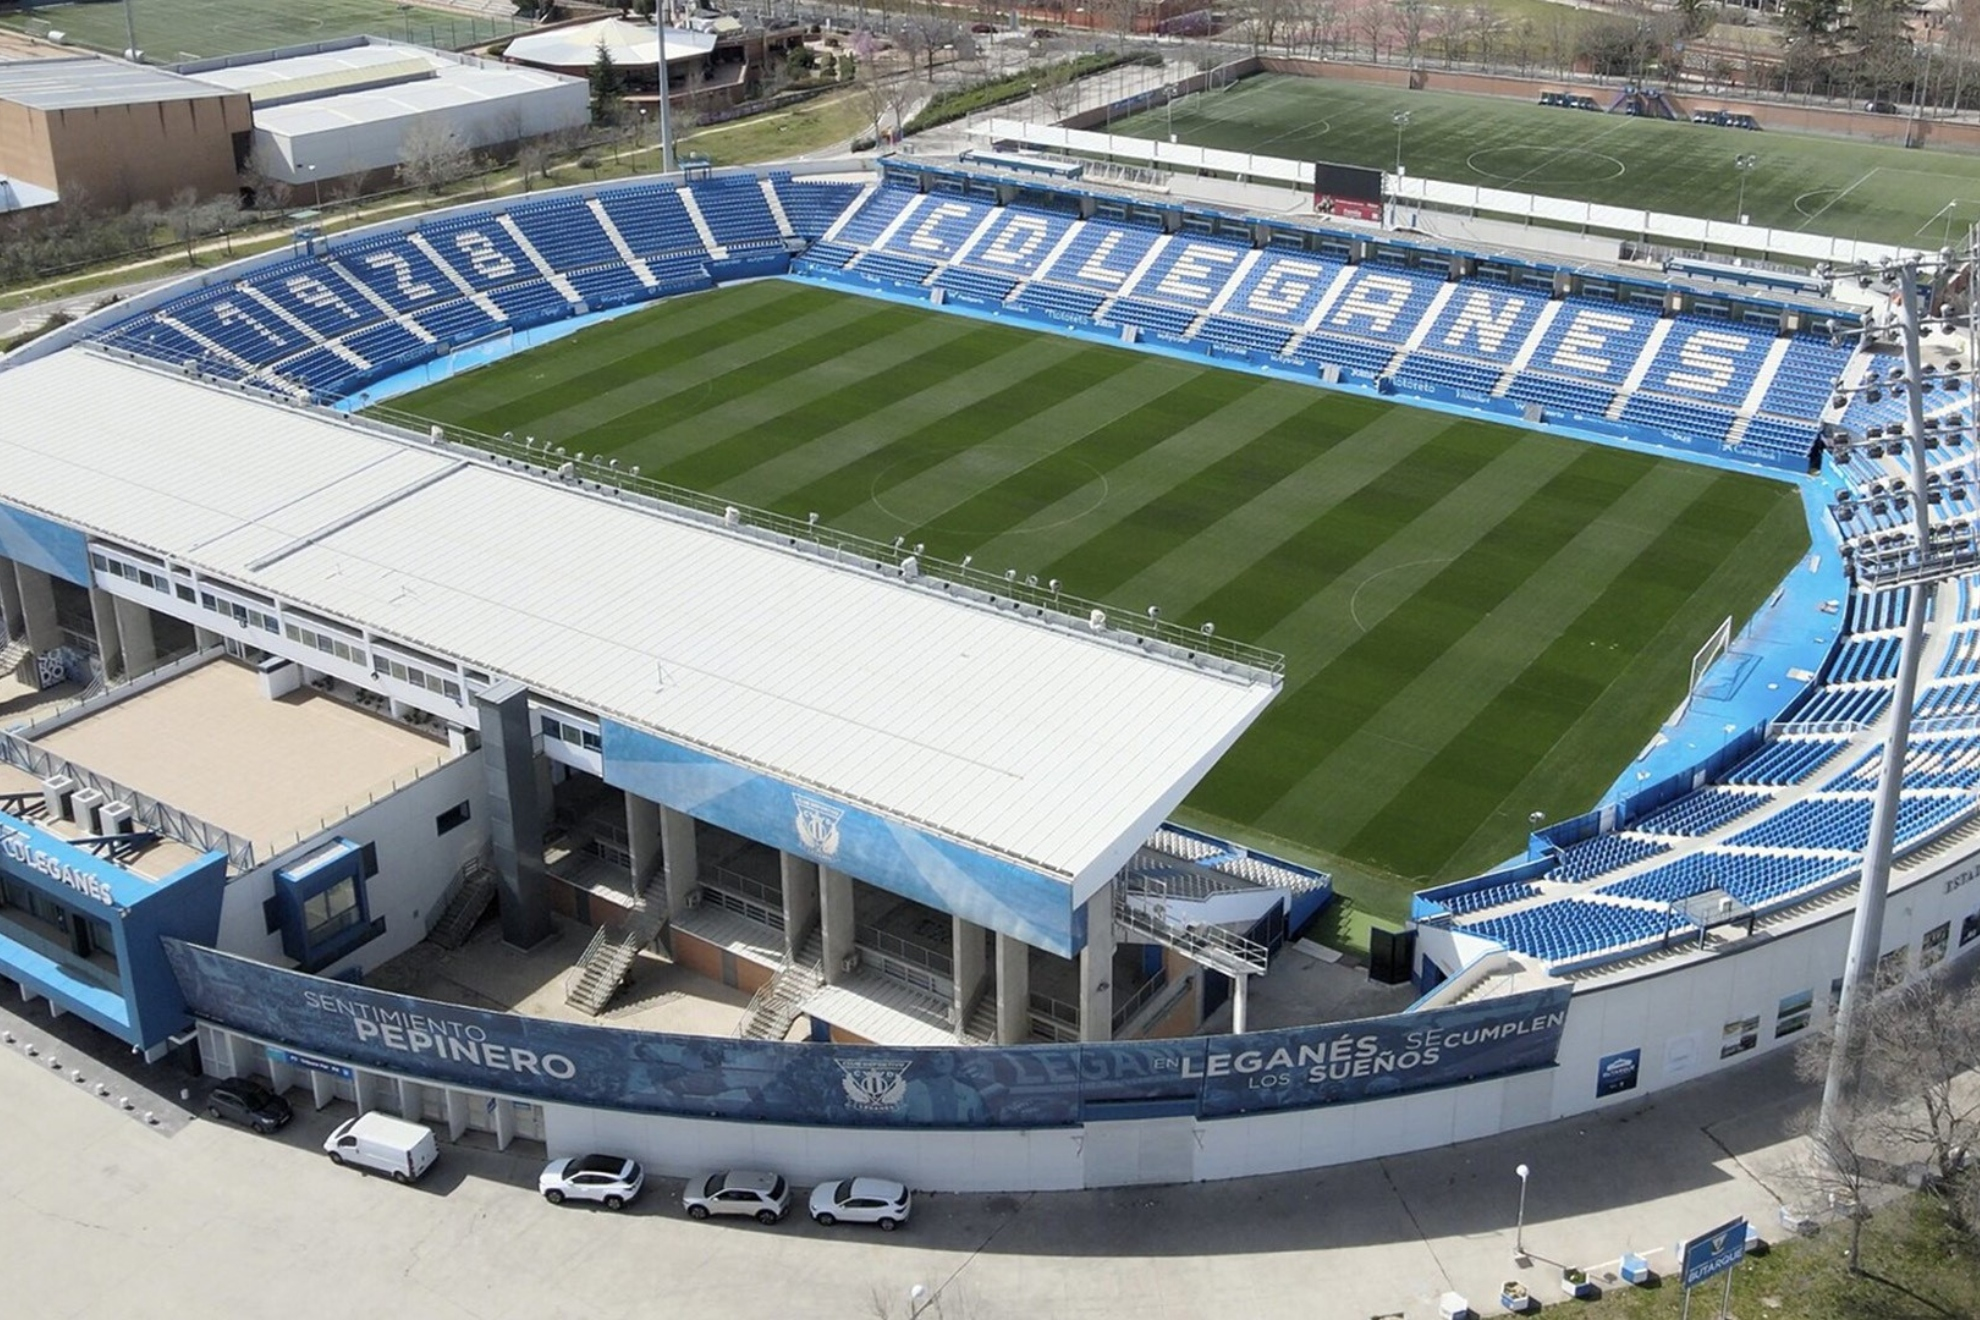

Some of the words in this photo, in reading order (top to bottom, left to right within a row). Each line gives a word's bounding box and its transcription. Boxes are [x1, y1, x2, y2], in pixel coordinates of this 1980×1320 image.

[304, 990, 486, 1042] SENTIMIENTO
[354, 1017, 576, 1080] PEPINERO
[1154, 1057, 1178, 1070] EN
[1182, 1034, 1378, 1079] LEGANÉS
[1405, 1028, 1444, 1050] SE
[1443, 1012, 1565, 1048] CUMPLEN
[1249, 1073, 1291, 1089] LOS
[1308, 1047, 1440, 1083] SUEÑOS
[1688, 1247, 1744, 1283] BUTARQUE
